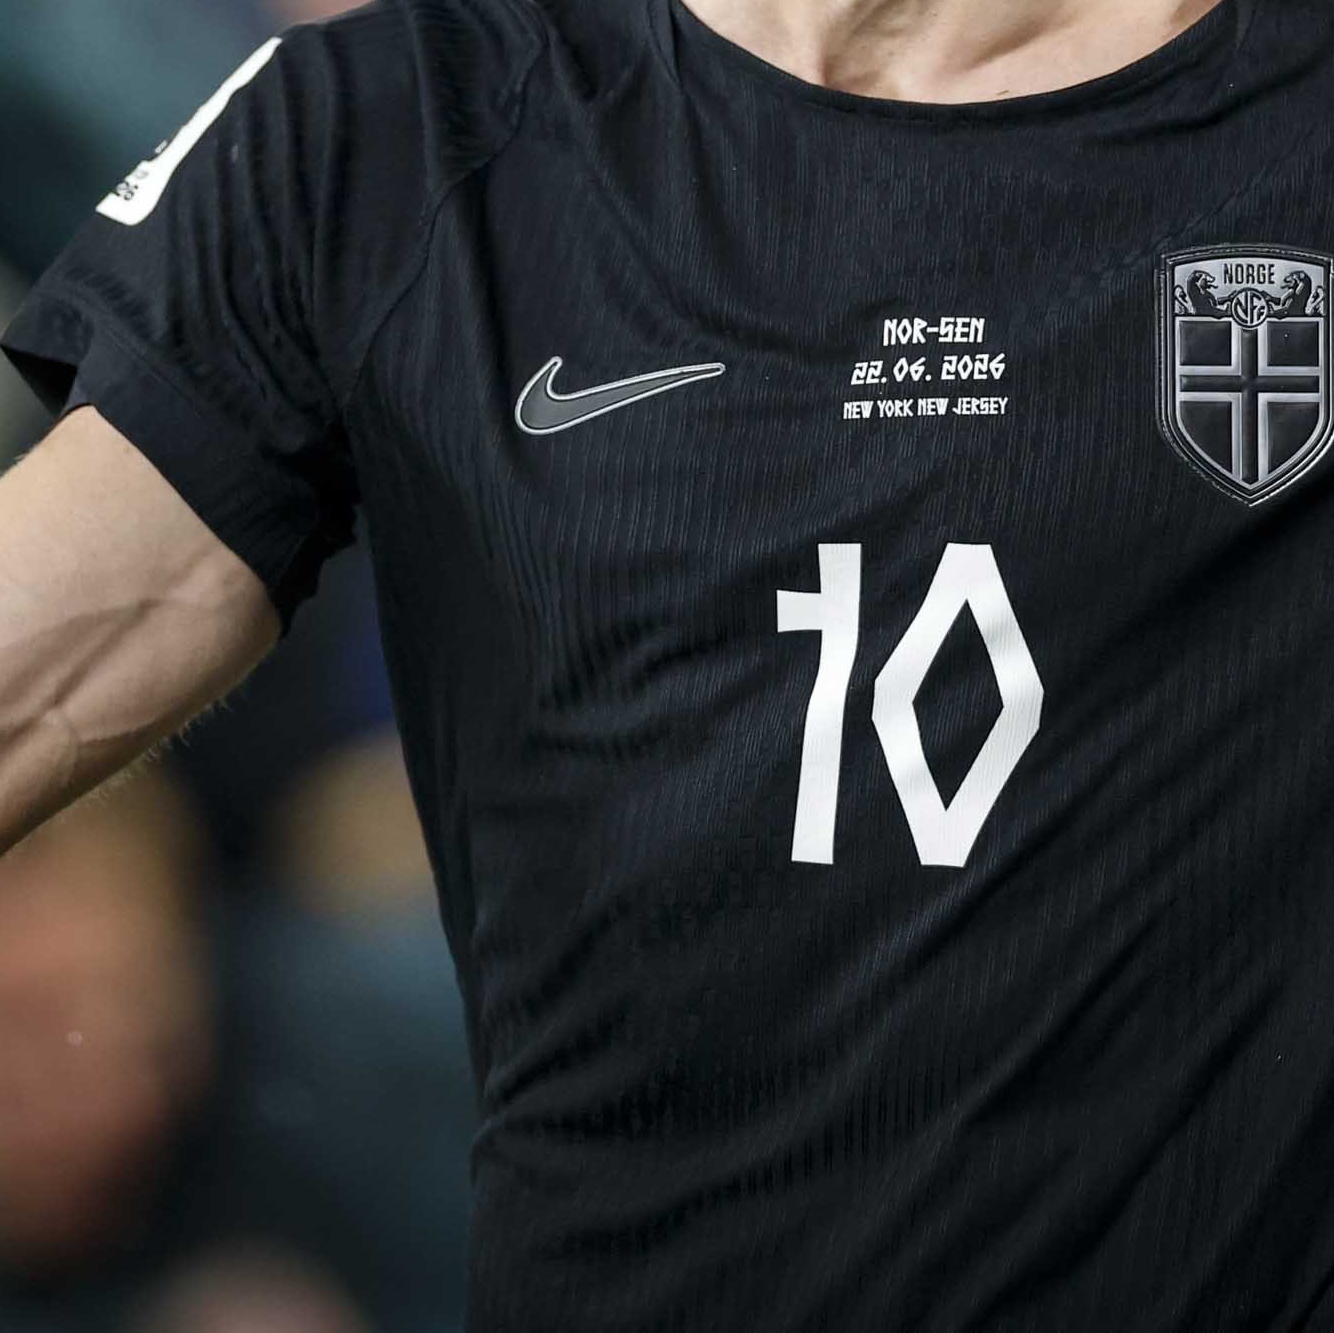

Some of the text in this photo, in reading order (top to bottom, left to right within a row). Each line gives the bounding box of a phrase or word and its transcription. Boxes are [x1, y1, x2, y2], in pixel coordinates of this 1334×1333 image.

[1223, 263, 1276, 285] NORGE
[883, 317, 985, 346] NOR-SEN
[842, 396, 1009, 419] NEW YORK NEW JERSEY
[776, 542, 1044, 867] 10
